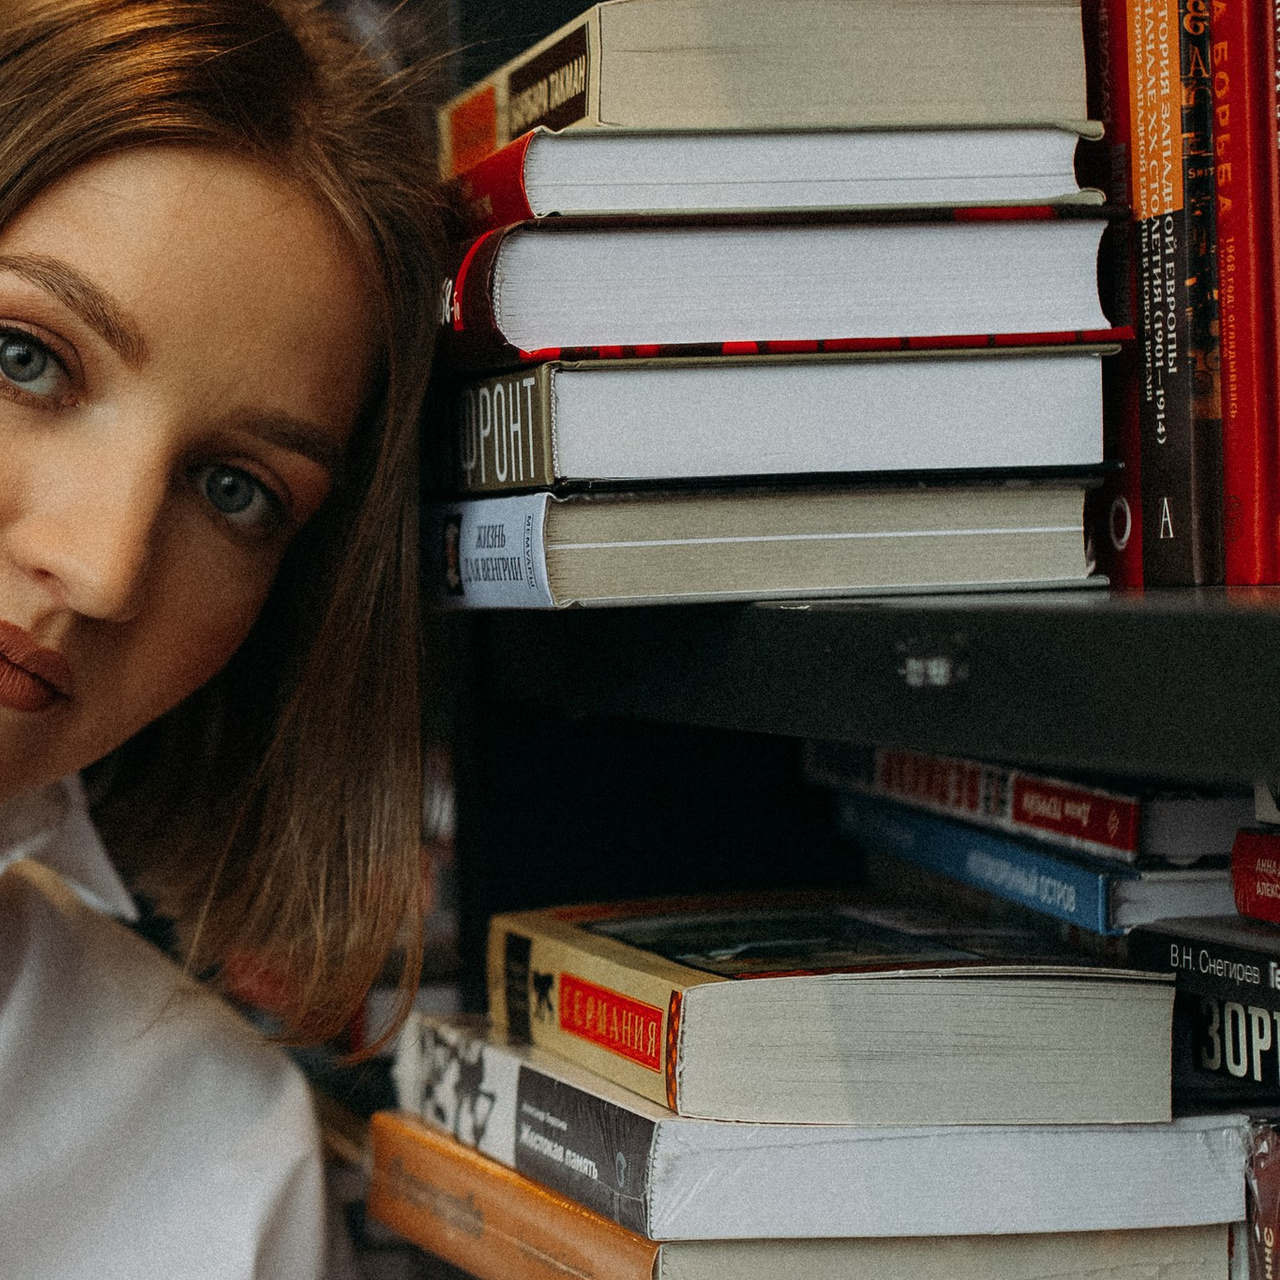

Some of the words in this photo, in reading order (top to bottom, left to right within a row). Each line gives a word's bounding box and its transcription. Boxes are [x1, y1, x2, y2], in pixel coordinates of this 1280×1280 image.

[1135, 68, 1148, 174] ЗАПАДНОЙ
[1212, 40, 1234, 212] БОРЬБА
[1159, 101, 1178, 255] ЗАПАДНОЙ
[1139, 176, 1151, 253] ЕВРОПЫ
[1149, 159, 1164, 303] СТОЛЕТИЯ
[1226, 235, 1236, 272] 1968
[1143, 269, 1152, 337] НОВОЕ
[1165, 261, 1178, 374] ЕВРОПЫ
[1145, 340, 1153, 402] ВРЕМЯ
[475, 523, 507, 549] ЖИЗНЬ
[482, 556, 523, 582] ВЕНГРИИ
[1170, 943, 1196, 971] В.Н.
[1199, 949, 1260, 986] Снегирев
[563, 984, 658, 1058] ГЕРМАНИЯ
[565, 1148, 599, 1181] память
